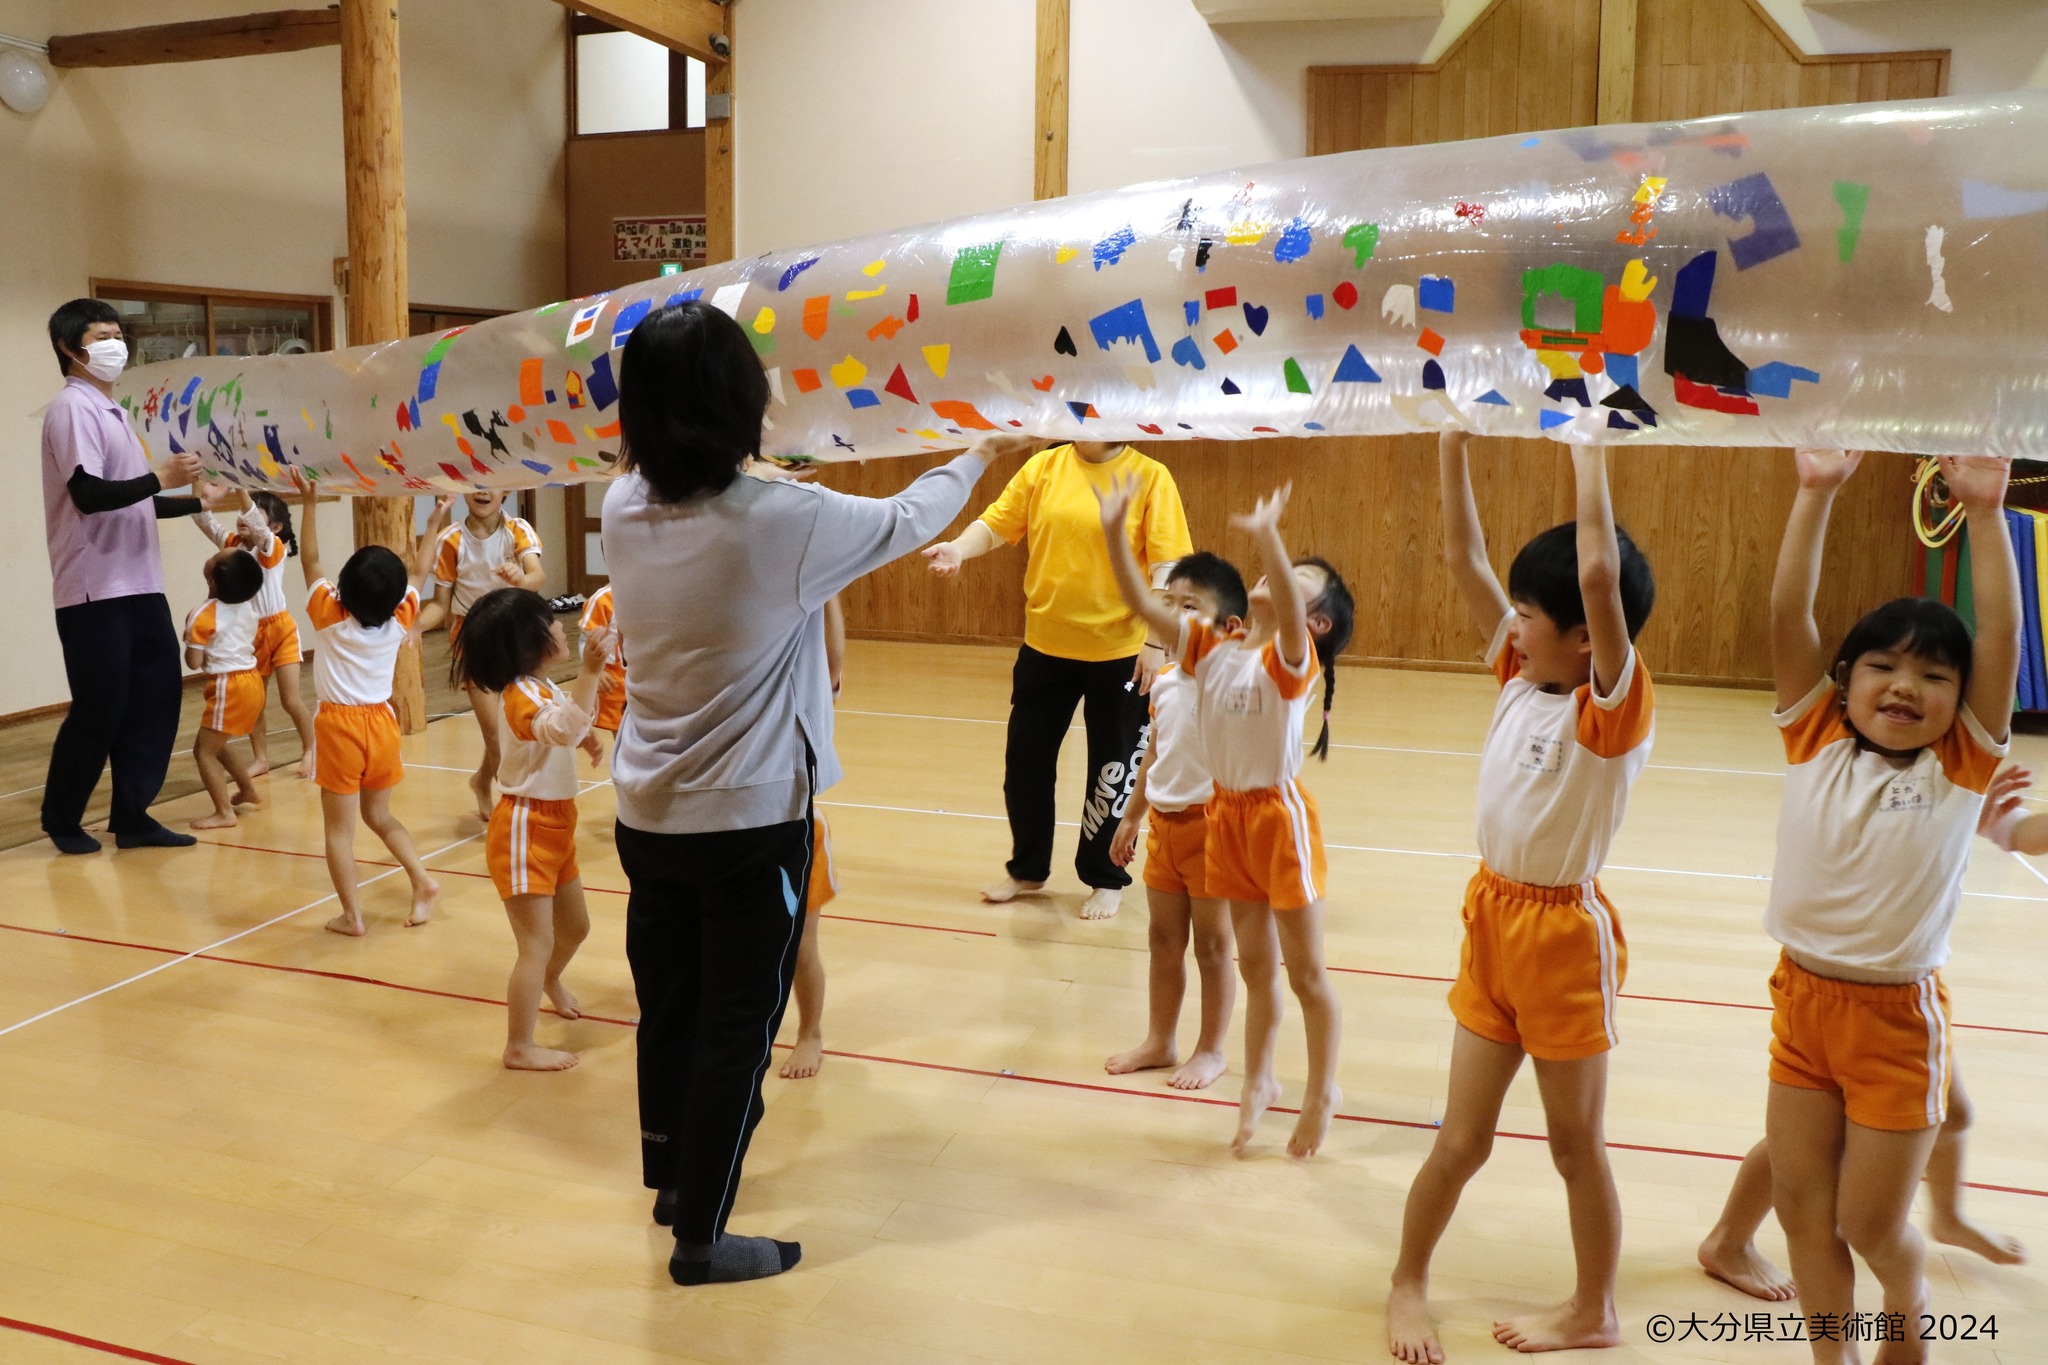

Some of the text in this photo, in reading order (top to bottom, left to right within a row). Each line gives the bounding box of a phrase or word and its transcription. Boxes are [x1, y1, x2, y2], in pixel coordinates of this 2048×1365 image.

[618, 235, 666, 250] スマイル
[1083, 761, 1126, 841] Move
